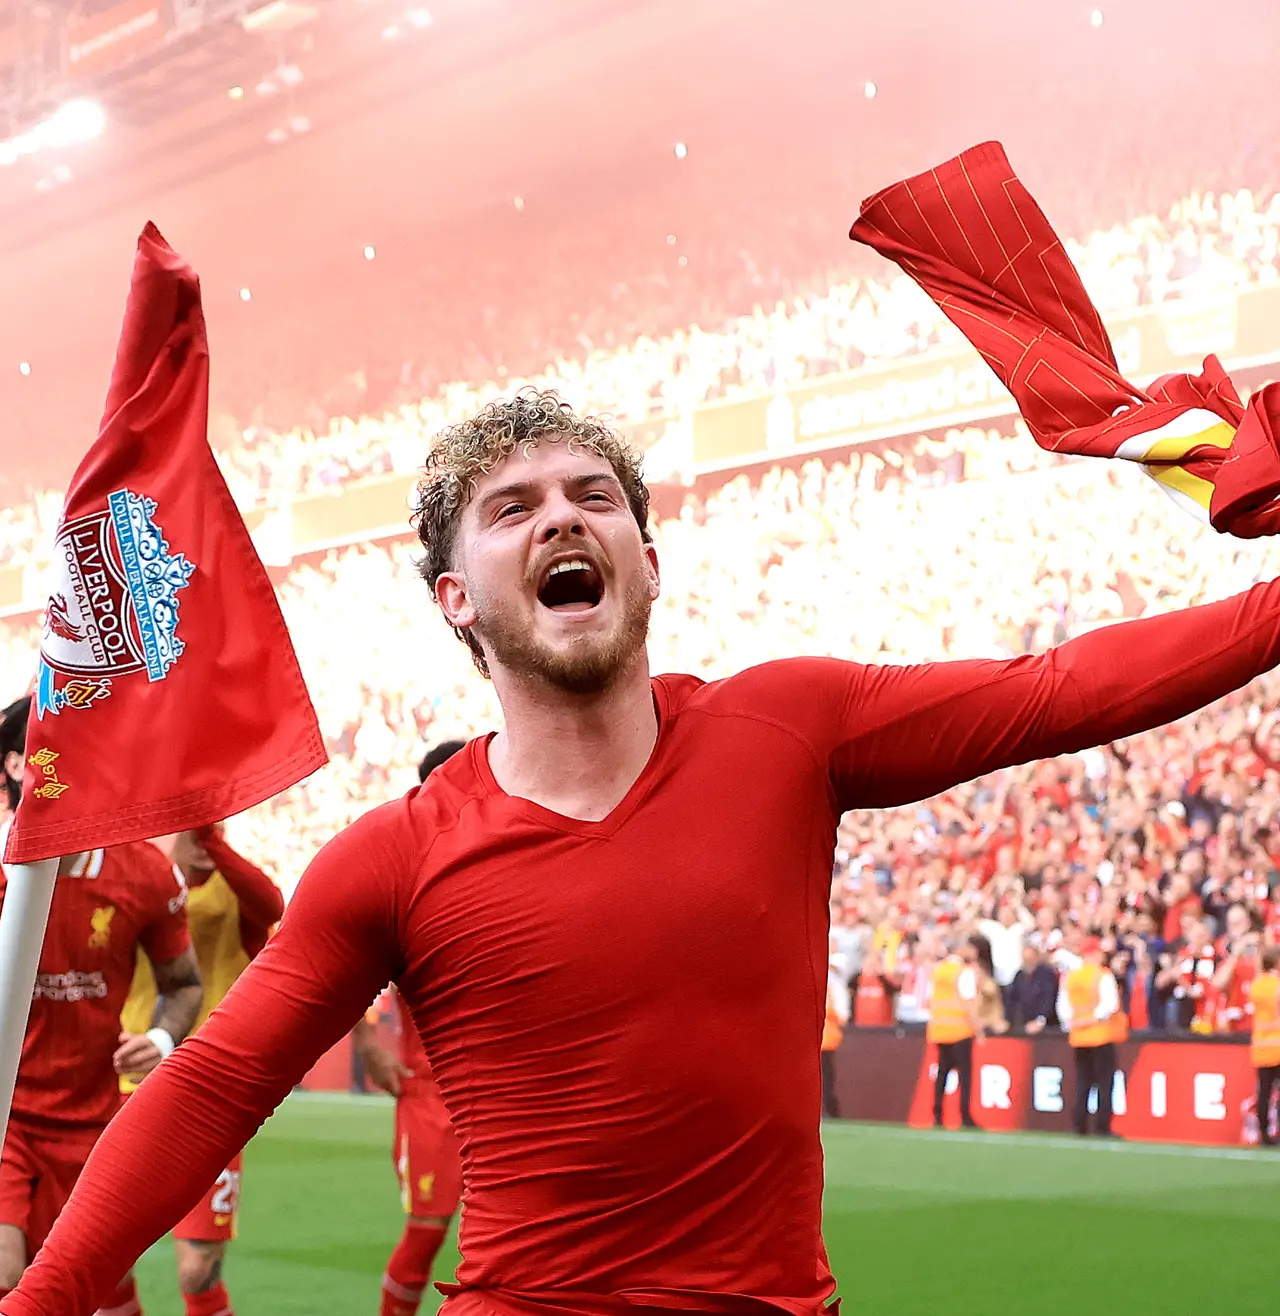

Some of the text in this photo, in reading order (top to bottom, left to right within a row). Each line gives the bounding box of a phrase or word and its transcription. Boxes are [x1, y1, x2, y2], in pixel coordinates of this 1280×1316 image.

[63, 542, 105, 663] FOOTBALL CLUB
[74, 530, 126, 666] LIVERPOOL
[112, 494, 161, 677] YOU'LL NEVER WALK ALONE
[43, 764, 59, 783] 97
